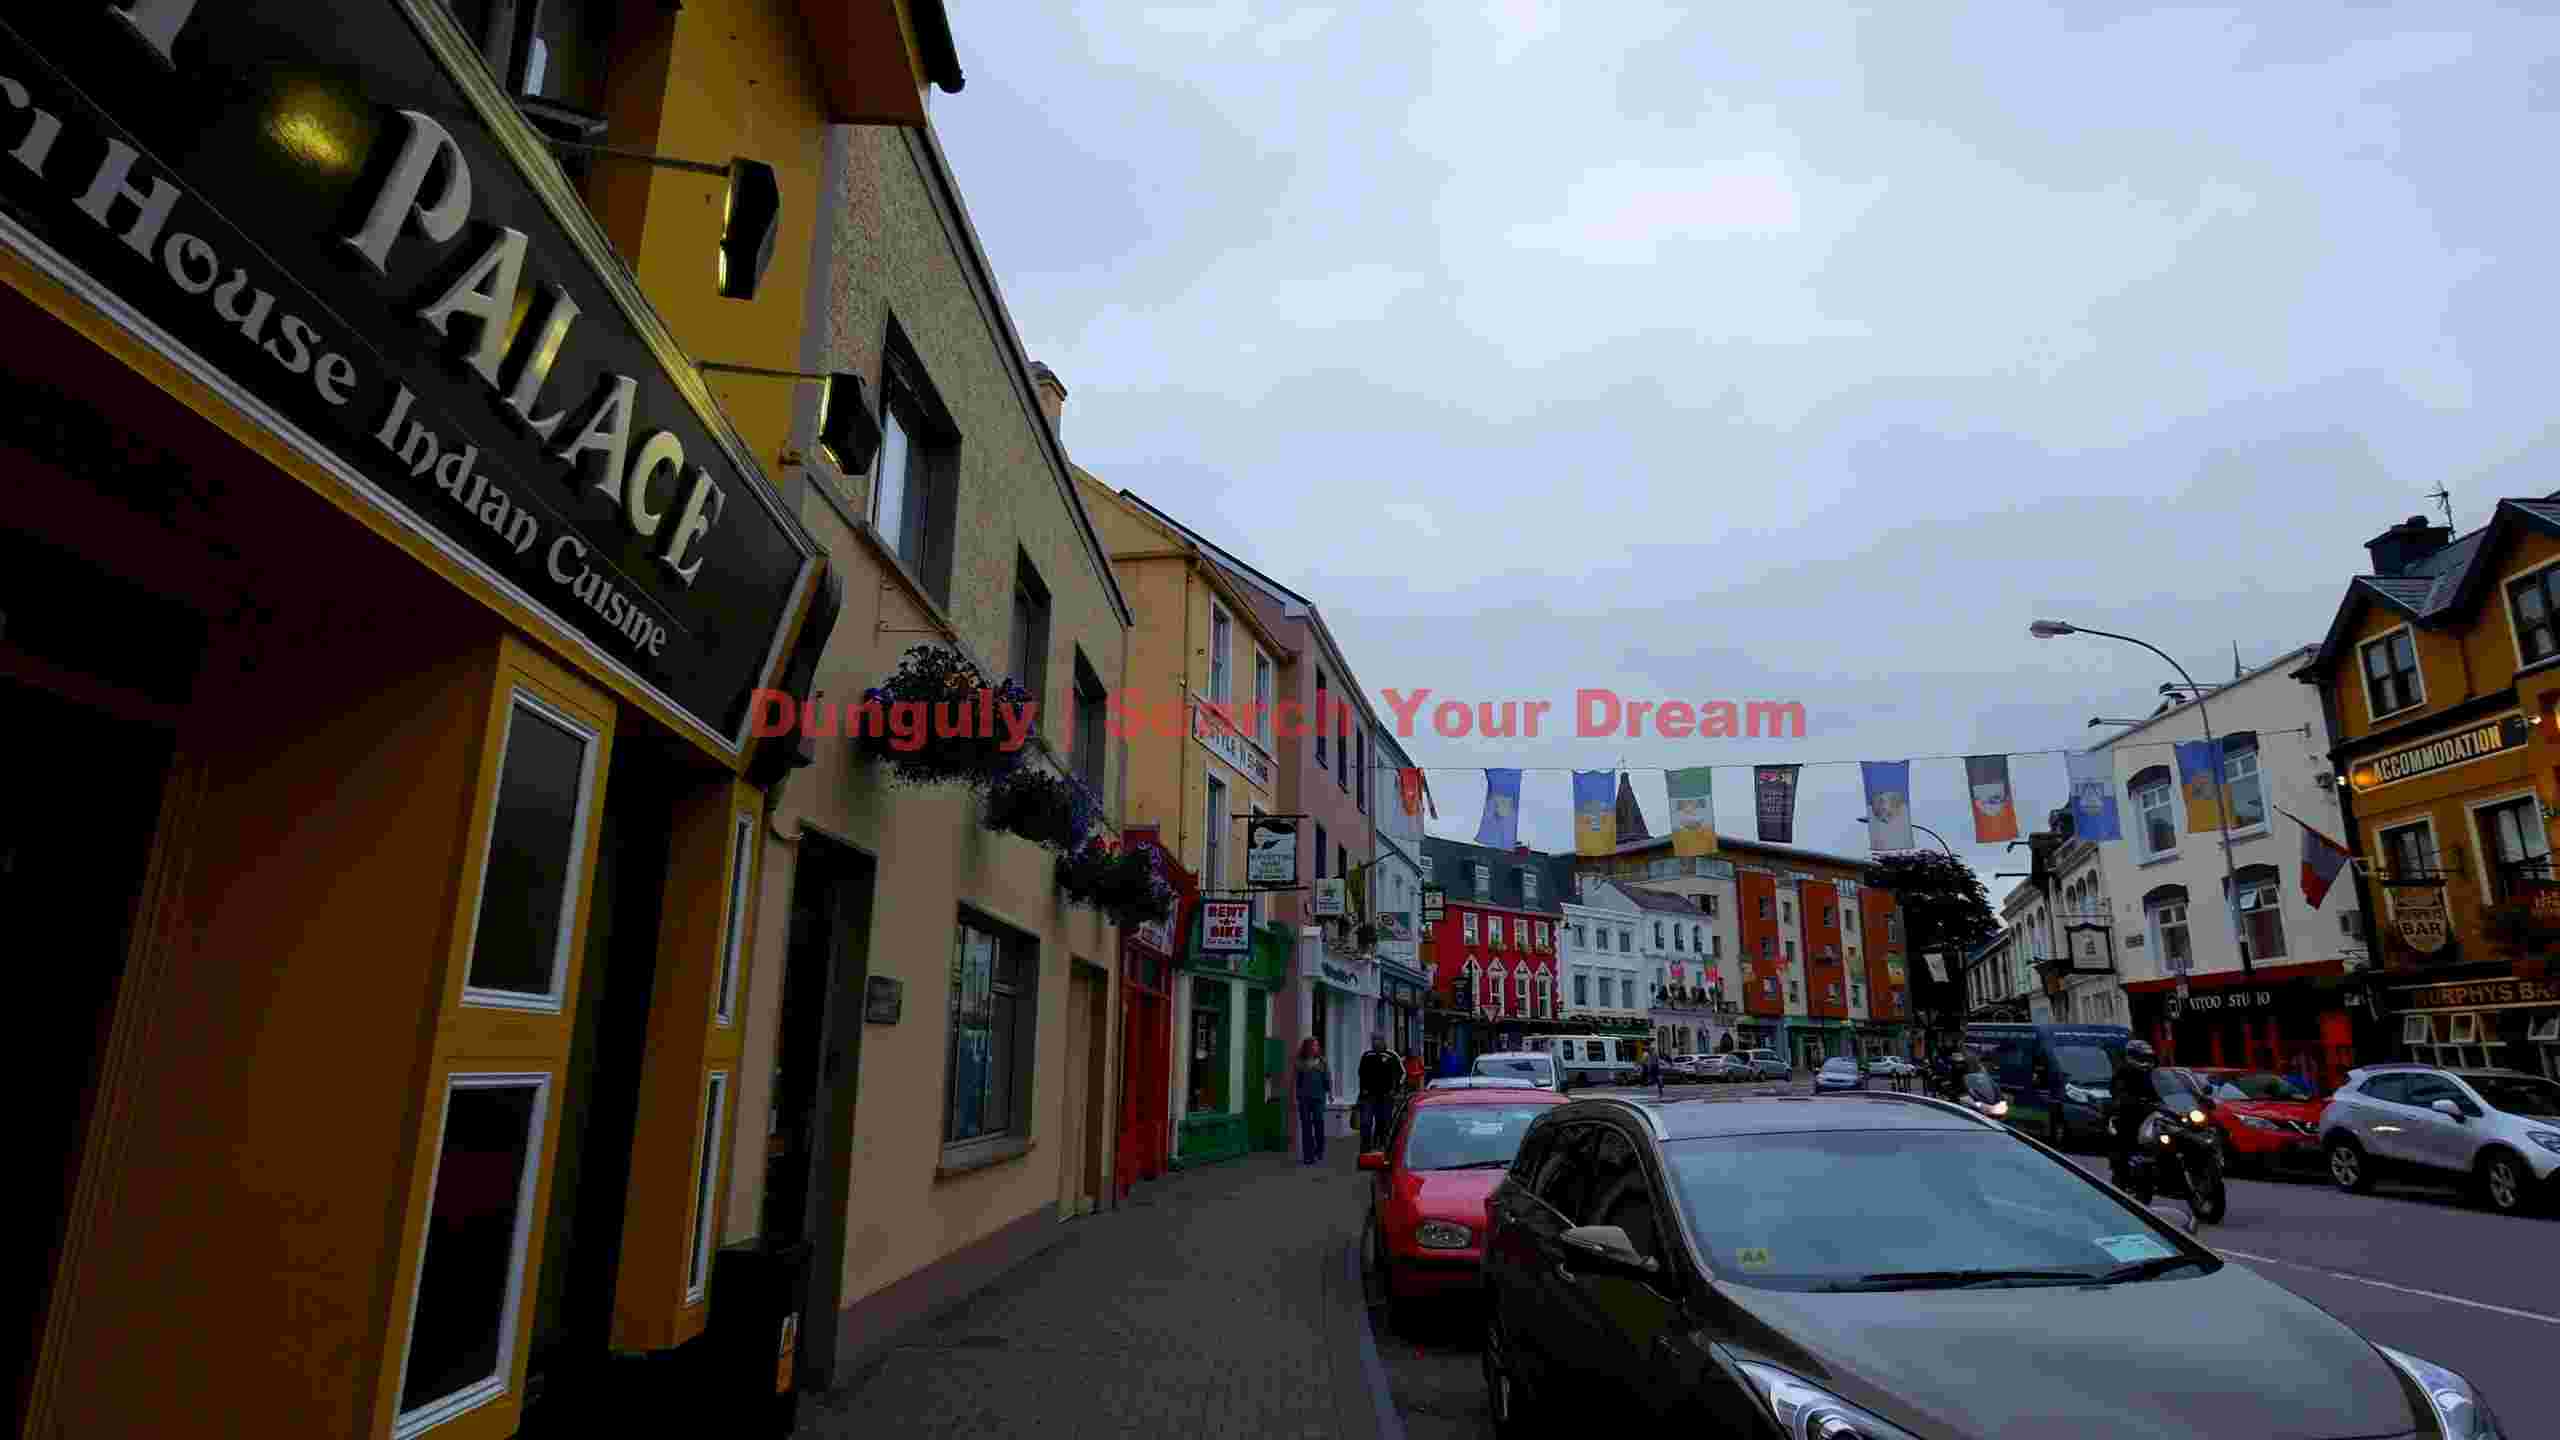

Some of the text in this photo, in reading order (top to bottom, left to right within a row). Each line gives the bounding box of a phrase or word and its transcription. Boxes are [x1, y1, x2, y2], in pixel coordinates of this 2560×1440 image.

[341, 109, 726, 586] PALACE
[72, 136, 669, 657] House Indian Cuisine
[2373, 725, 2503, 783] ACCOMMODATION
[1208, 906, 1246, 918] RENT
[1211, 926, 1244, 938] BIKE
[2401, 922, 2442, 936] BAR
[2227, 991, 2272, 1008] STUIO
